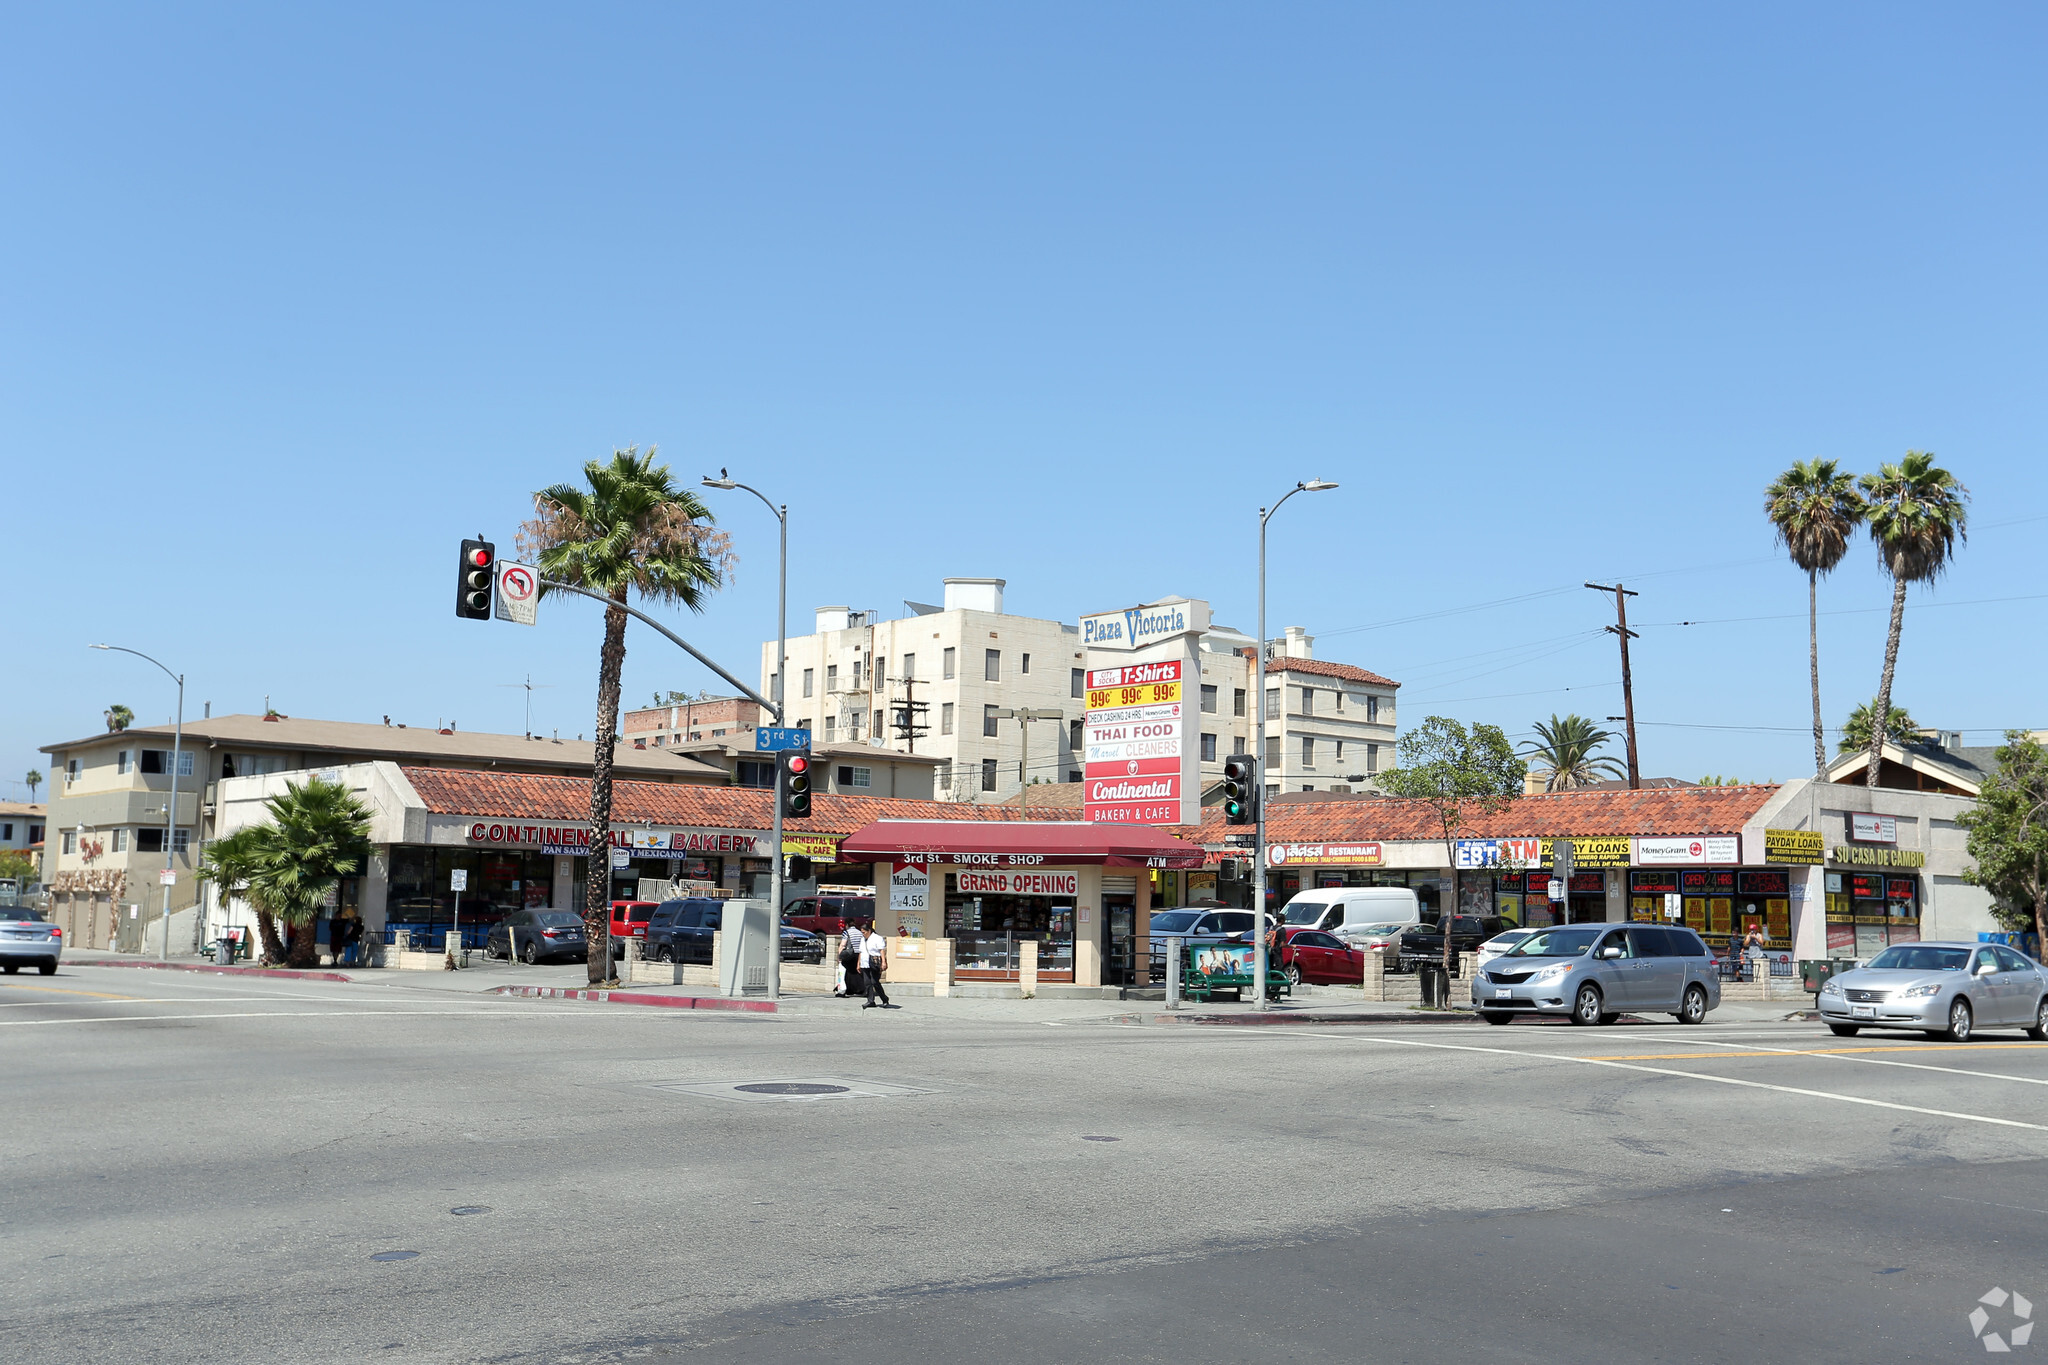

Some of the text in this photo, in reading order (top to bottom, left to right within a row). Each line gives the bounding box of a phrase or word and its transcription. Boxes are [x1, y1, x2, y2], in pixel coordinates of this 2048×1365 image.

[1084, 607, 1185, 646] Plaza Victoria
[1124, 664, 1176, 684] T-Shirts
[1088, 713, 1104, 724] CHECK
[1104, 710, 1124, 722] CASHING
[1125, 710, 1131, 720] 24
[1144, 709, 1170, 718] MoneyGram
[760, 730, 784, 748] 3rd
[1094, 724, 1173, 740] THAI FOOD
[1090, 740, 1178, 758] Marvel CLEANERS
[1092, 778, 1172, 800] Continental
[1094, 807, 1170, 821] BAKERY & CAFE
[470, 822, 758, 852] CONTINENAL BAKERY
[1766, 836, 1823, 849] PAYDAY LOANS
[542, 845, 562, 854] PAN
[630, 849, 638, 857] Y
[638, 850, 684, 858] MEXICANO
[806, 846, 830, 854] & CAFE
[1329, 846, 1377, 856] RESTAURANT
[1501, 840, 1537, 860] ATM
[1542, 844, 1629, 853] PAAY LOANS
[904, 854, 1044, 865] 3rd St. SMOKE SHOP
[1146, 857, 1166, 867] ATM
[1459, 846, 1496, 866] EBT
[1837, 846, 1925, 868] SU CASA DE CAMBIO
[892, 873, 927, 886] Marlboro
[960, 874, 1076, 894] GRAND OPENING
[1639, 873, 1666, 885] EBT
[1685, 872, 1733, 888] OPEN 24 HRS
[1748, 874, 1780, 884] OPEN
[1760, 883, 1786, 892] DAYS
[1526, 895, 1548, 904] ATM
